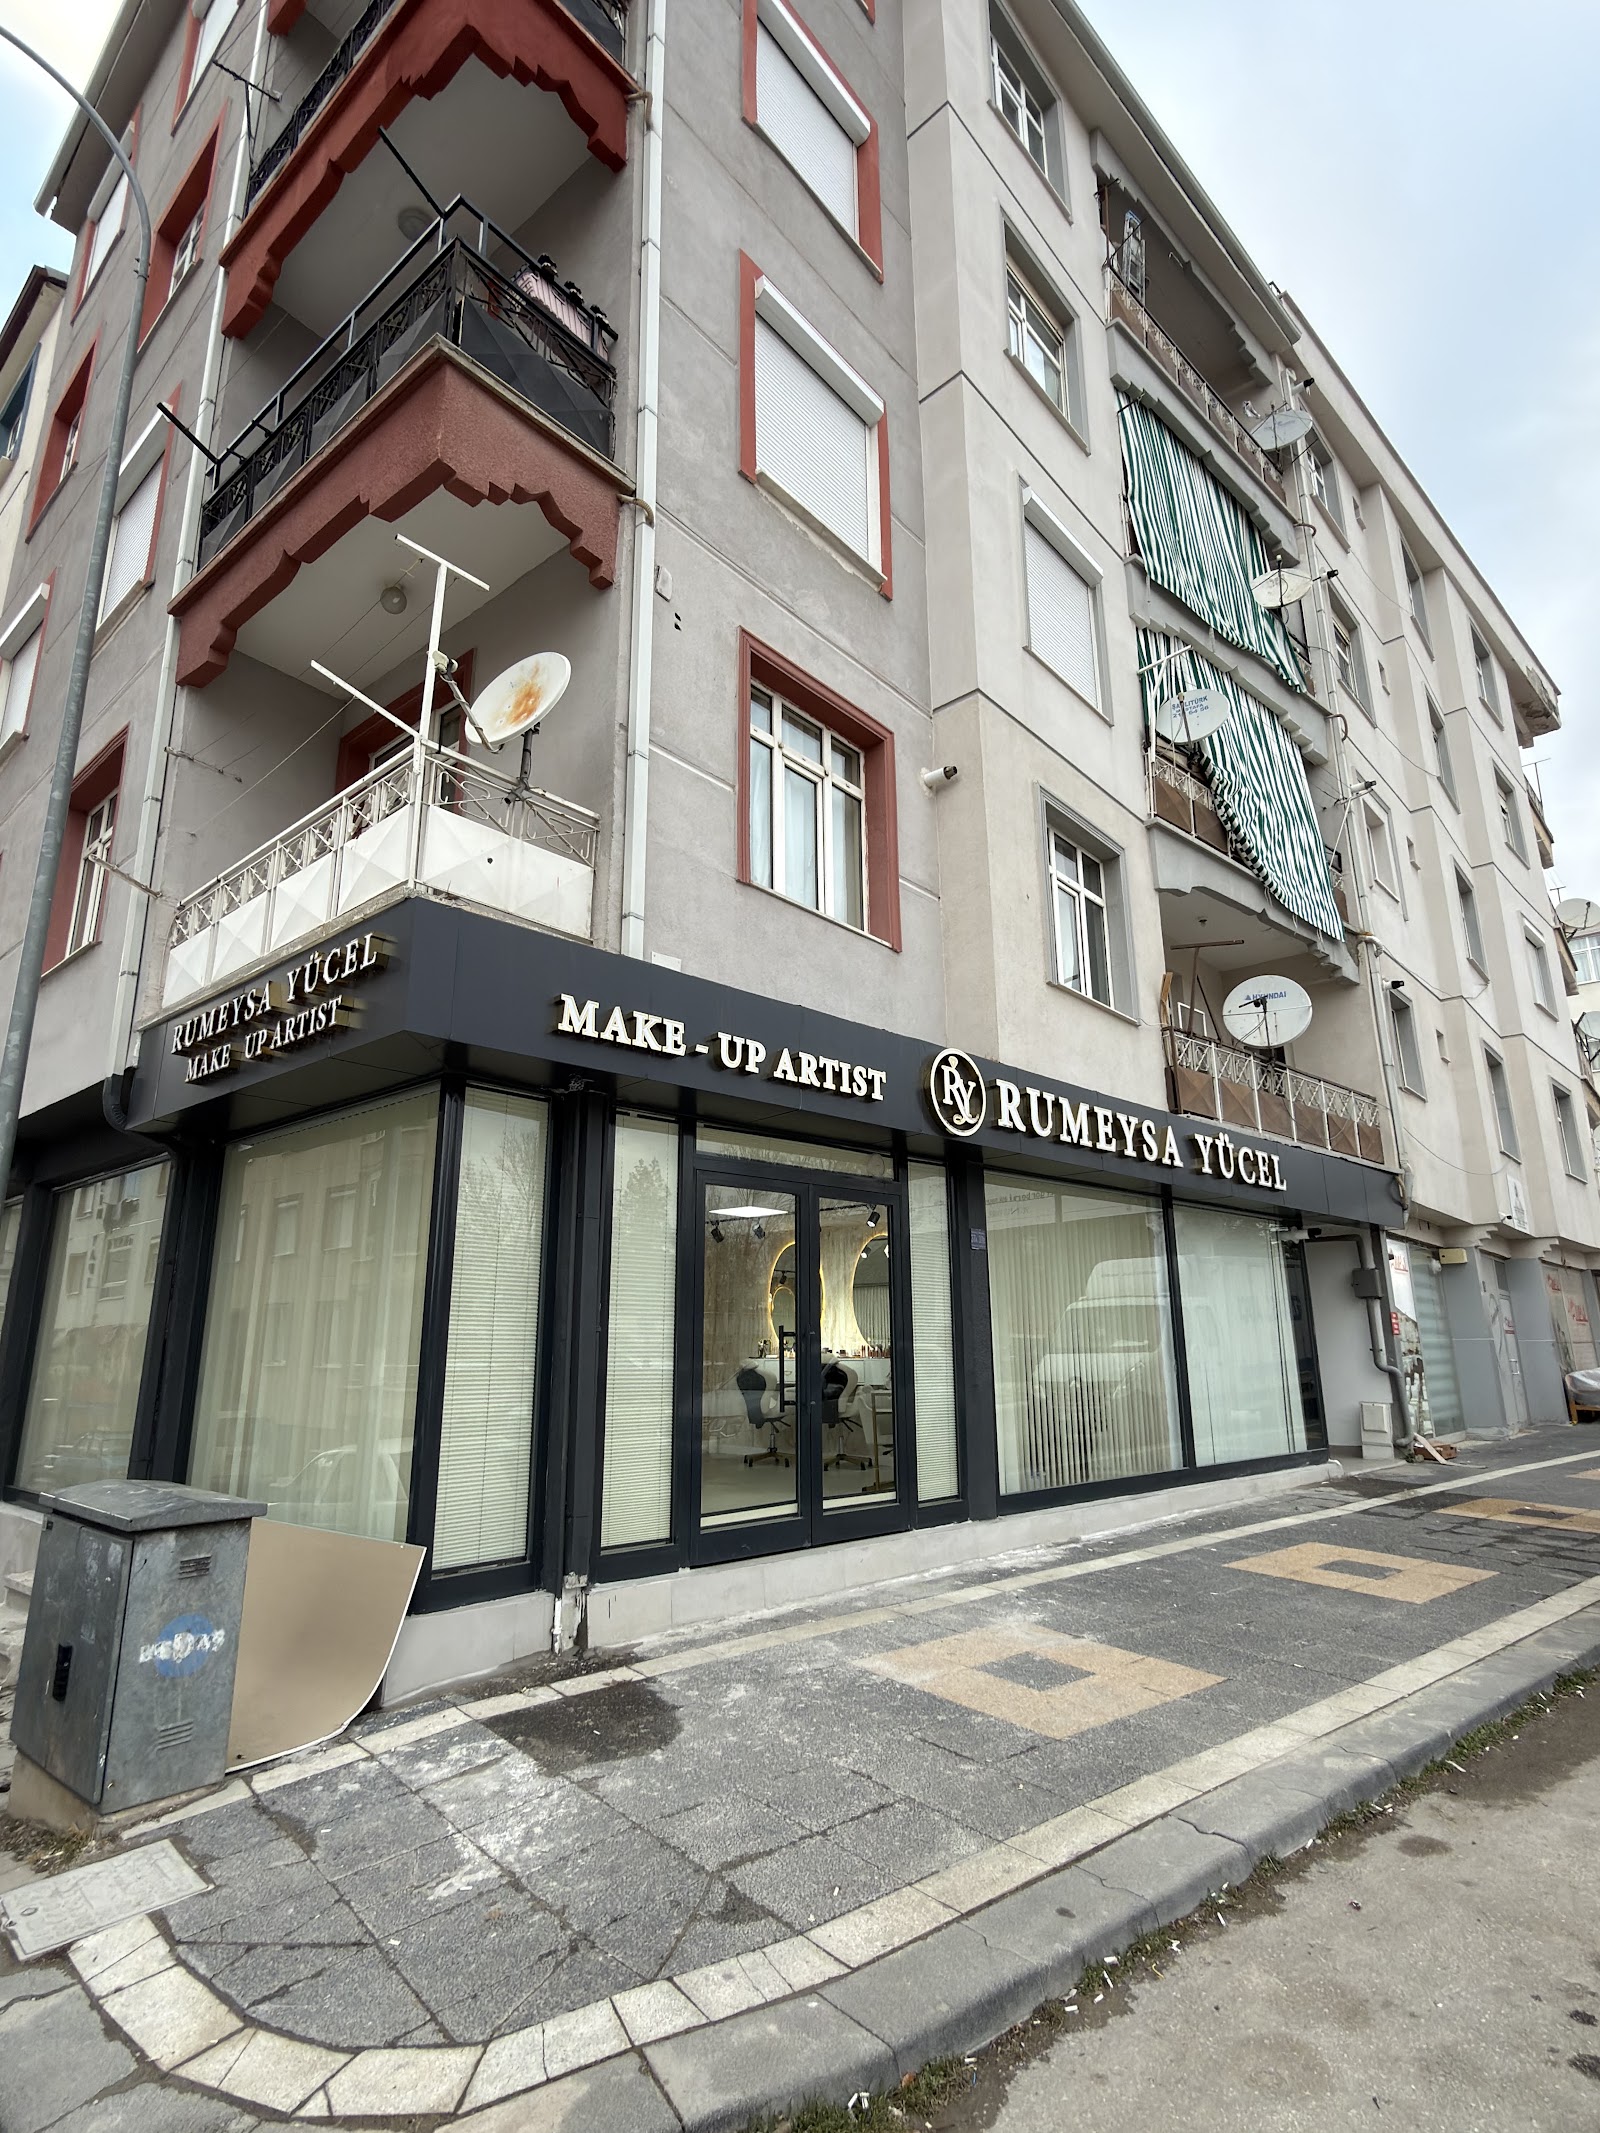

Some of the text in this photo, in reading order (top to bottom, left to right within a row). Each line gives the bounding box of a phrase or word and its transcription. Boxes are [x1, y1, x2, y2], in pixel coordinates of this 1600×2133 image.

[1172, 695, 1208, 710] ŞALITÜRK
[172, 932, 377, 1053] RUMEYSA YÜCEL
[185, 995, 342, 1083] MAKE UP ARTIST
[557, 993, 686, 1056] MAKE
[717, 1031, 767, 1074] UP
[773, 1047, 887, 1101] ARTIST
[996, 1079, 1287, 1191] RUMEYSA YÜCEL
